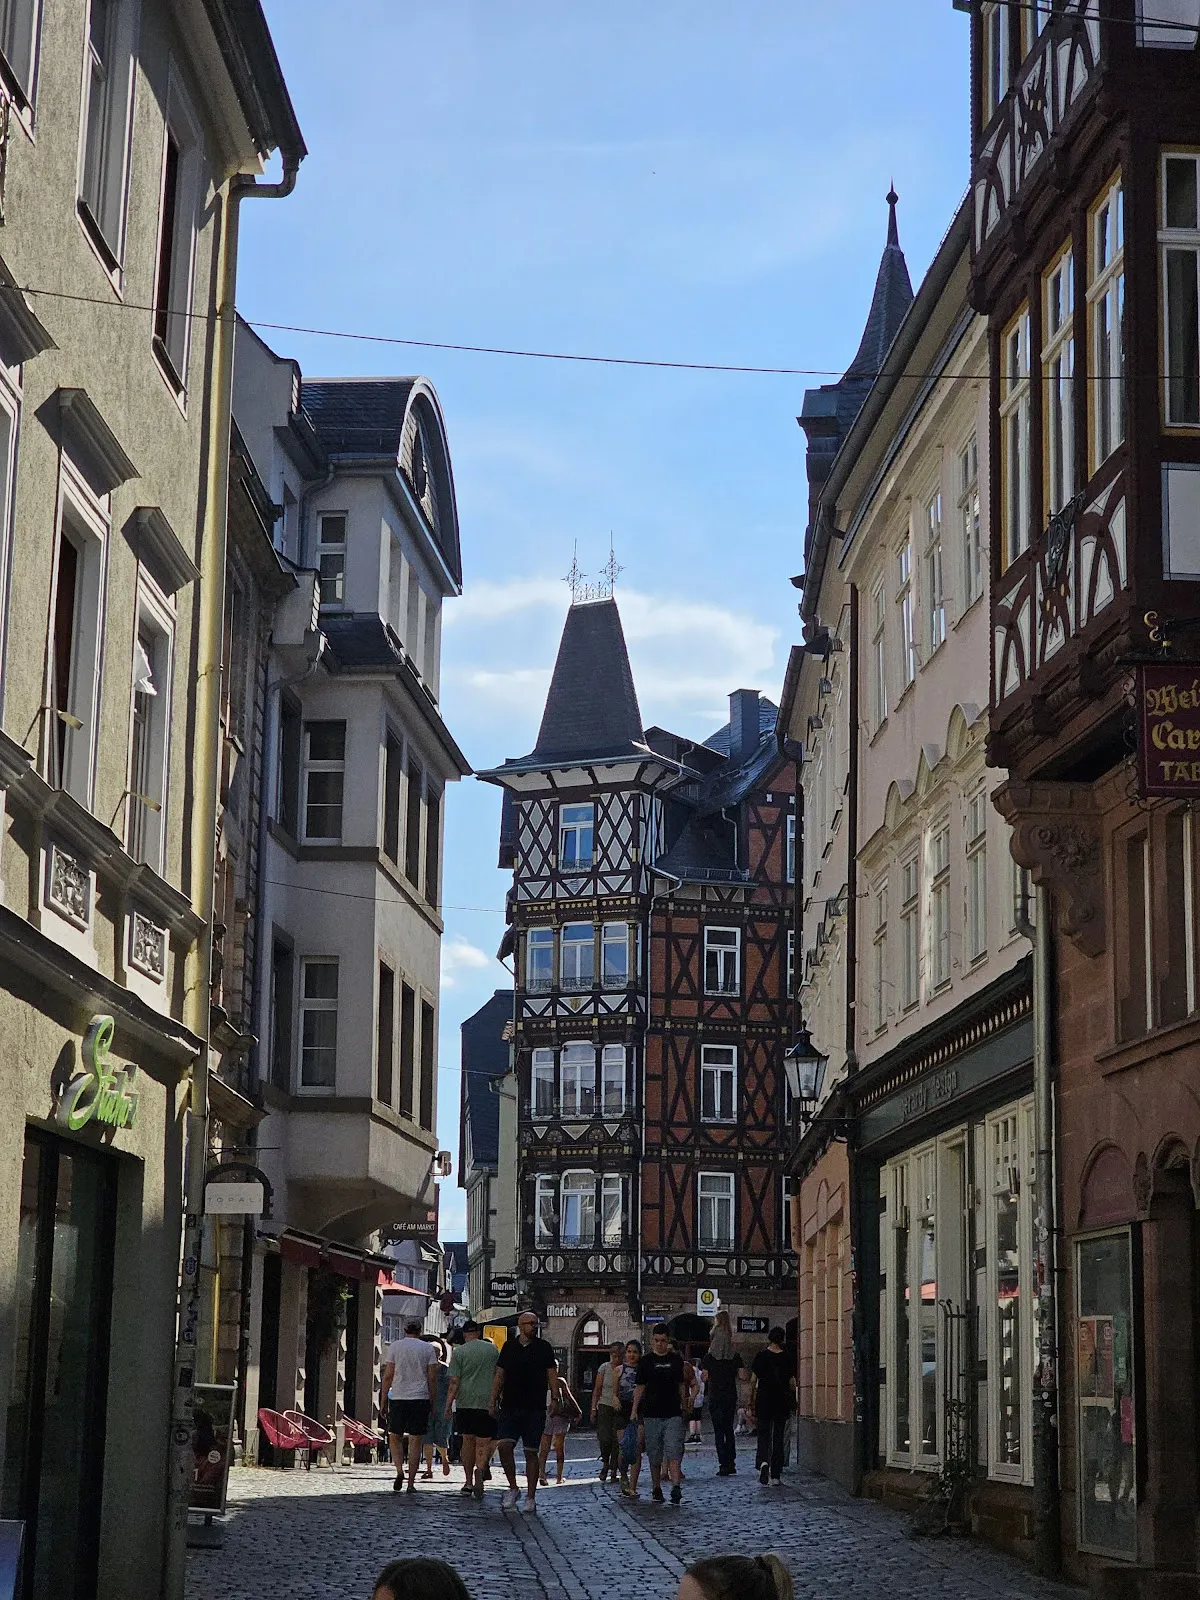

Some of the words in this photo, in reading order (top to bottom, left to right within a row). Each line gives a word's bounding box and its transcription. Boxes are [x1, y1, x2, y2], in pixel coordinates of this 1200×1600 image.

[1146, 679, 1200, 717] Wei
[393, 1221, 407, 1230] CAFÉ
[491, 1281, 516, 1291] Market
[546, 1304, 577, 1317] Market
